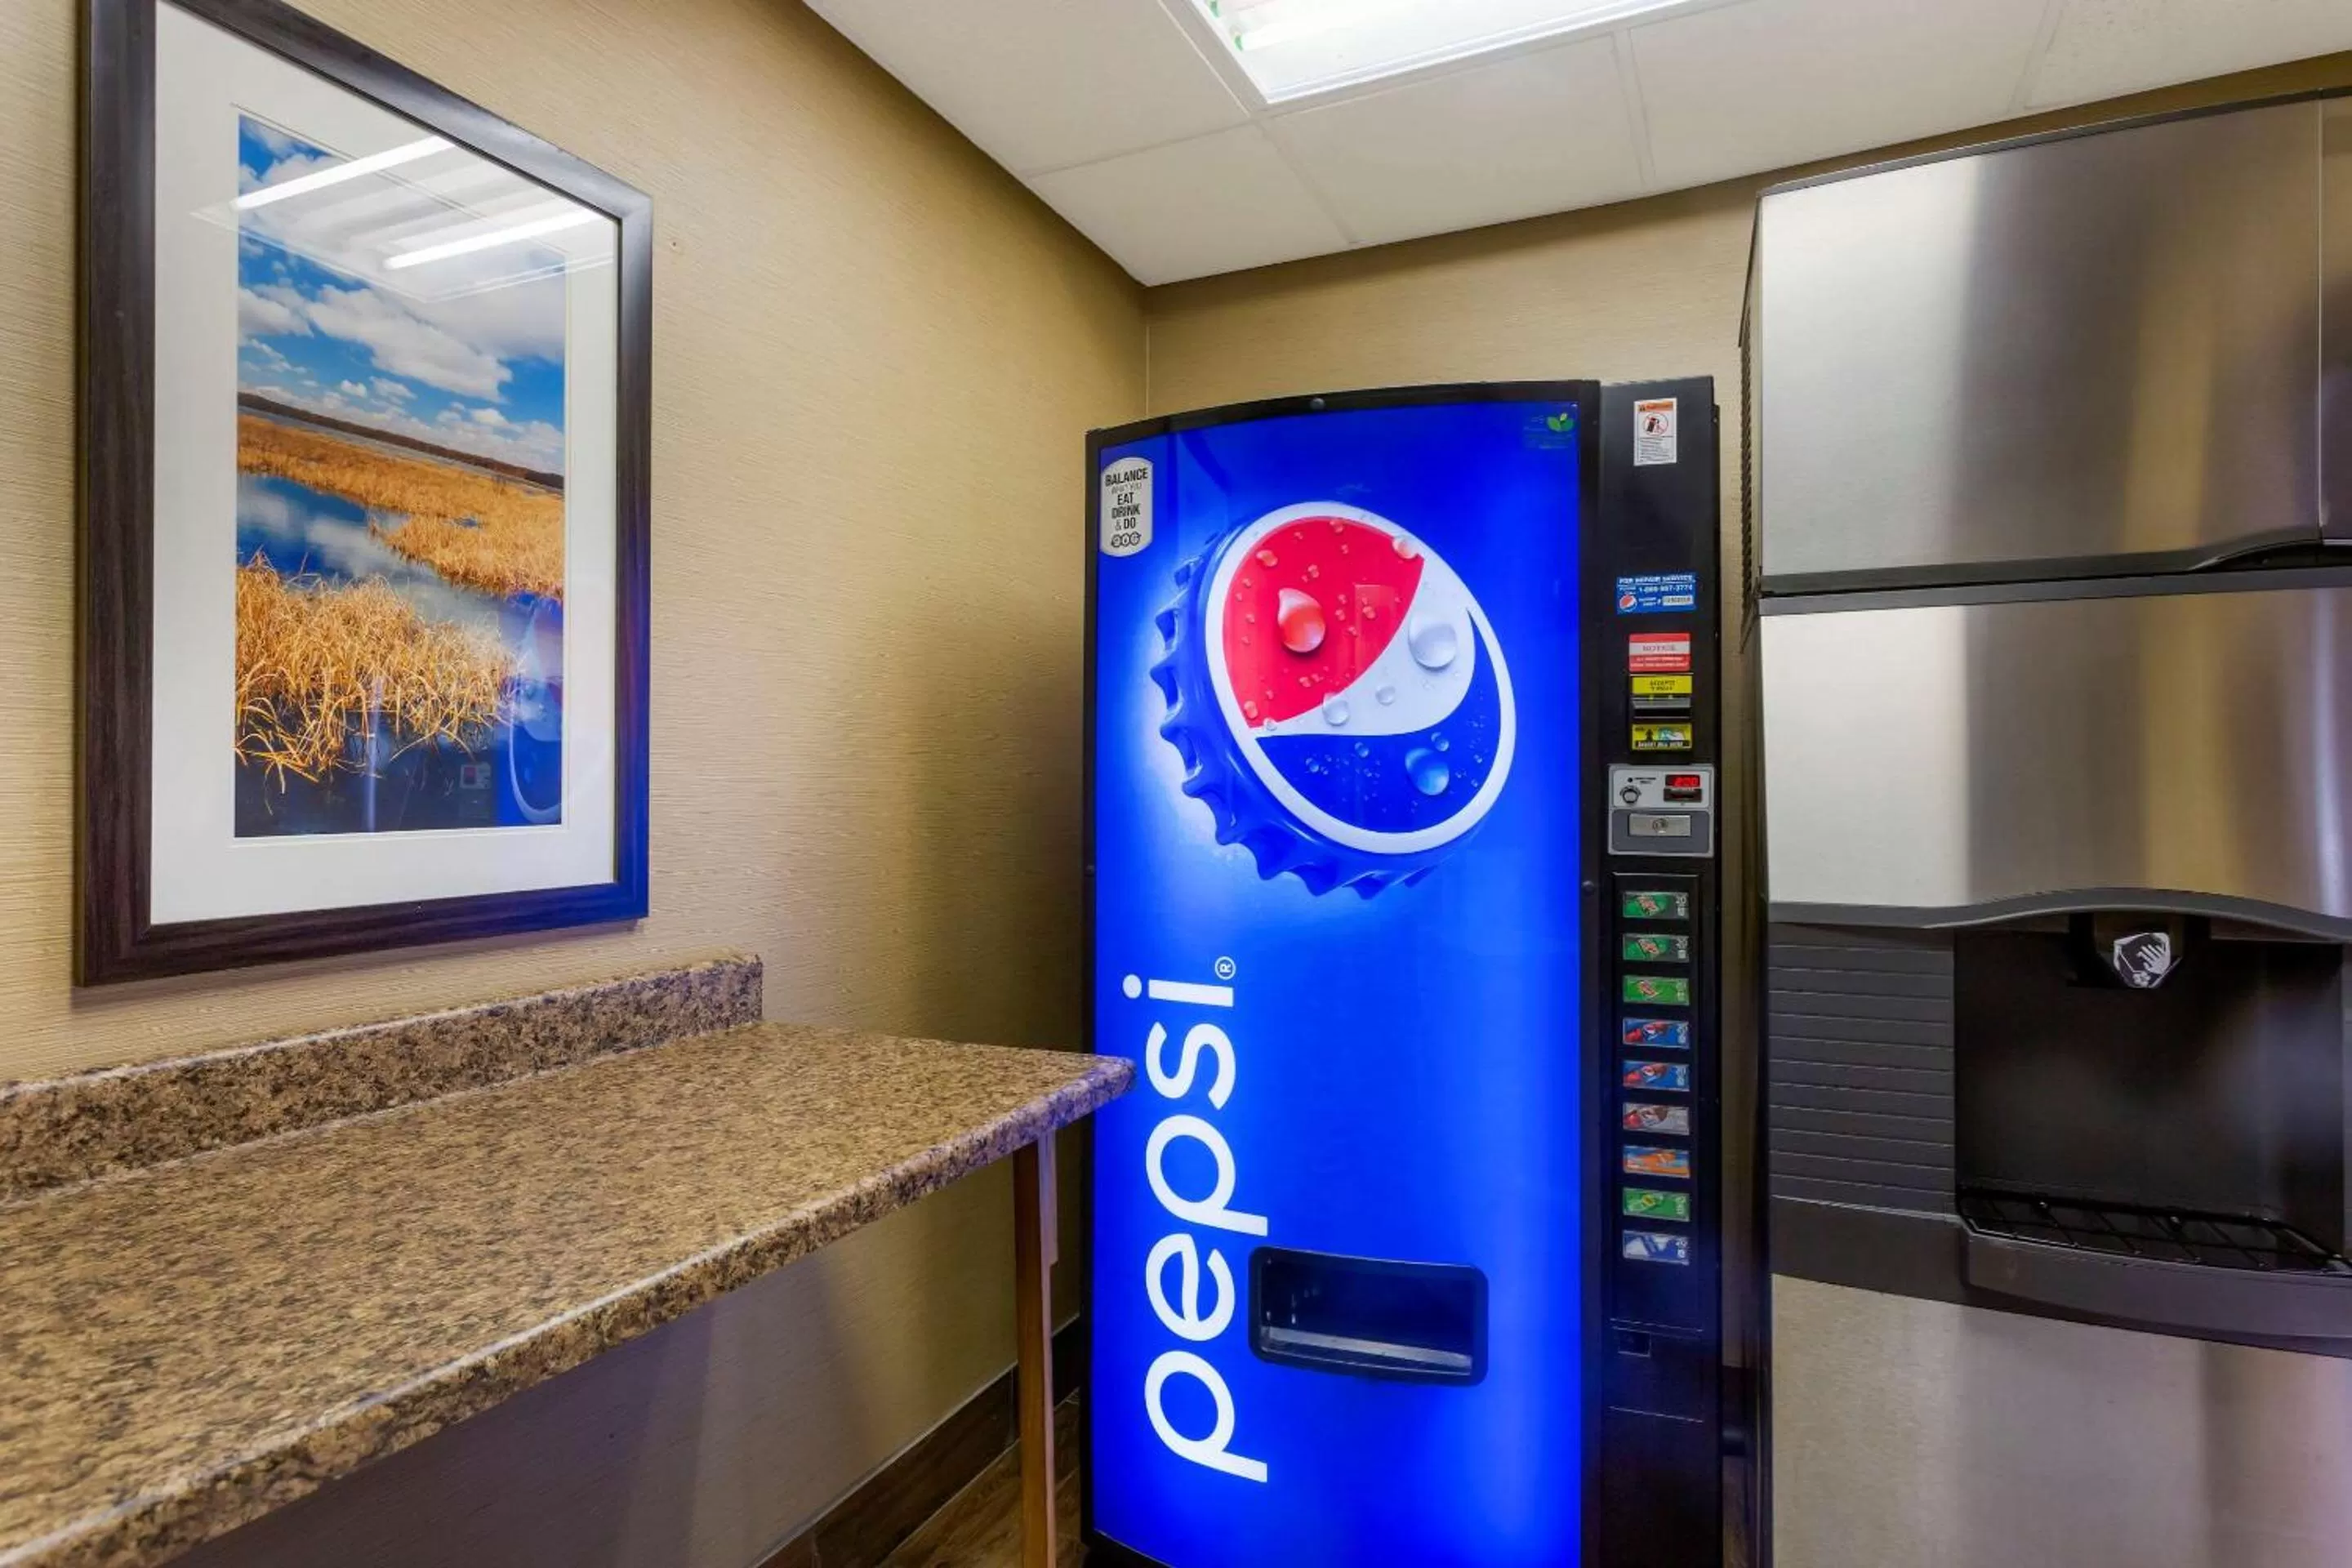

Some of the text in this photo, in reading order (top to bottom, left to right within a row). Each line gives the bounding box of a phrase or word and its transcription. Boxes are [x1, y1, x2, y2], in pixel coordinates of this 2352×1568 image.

[1105, 467, 1148, 487] BALANCE
[1117, 492, 1134, 506] EAT
[1111, 503, 1140, 519] DRINK
[1124, 517, 1136, 529] DO
[1123, 973, 1268, 1483] pepsi
